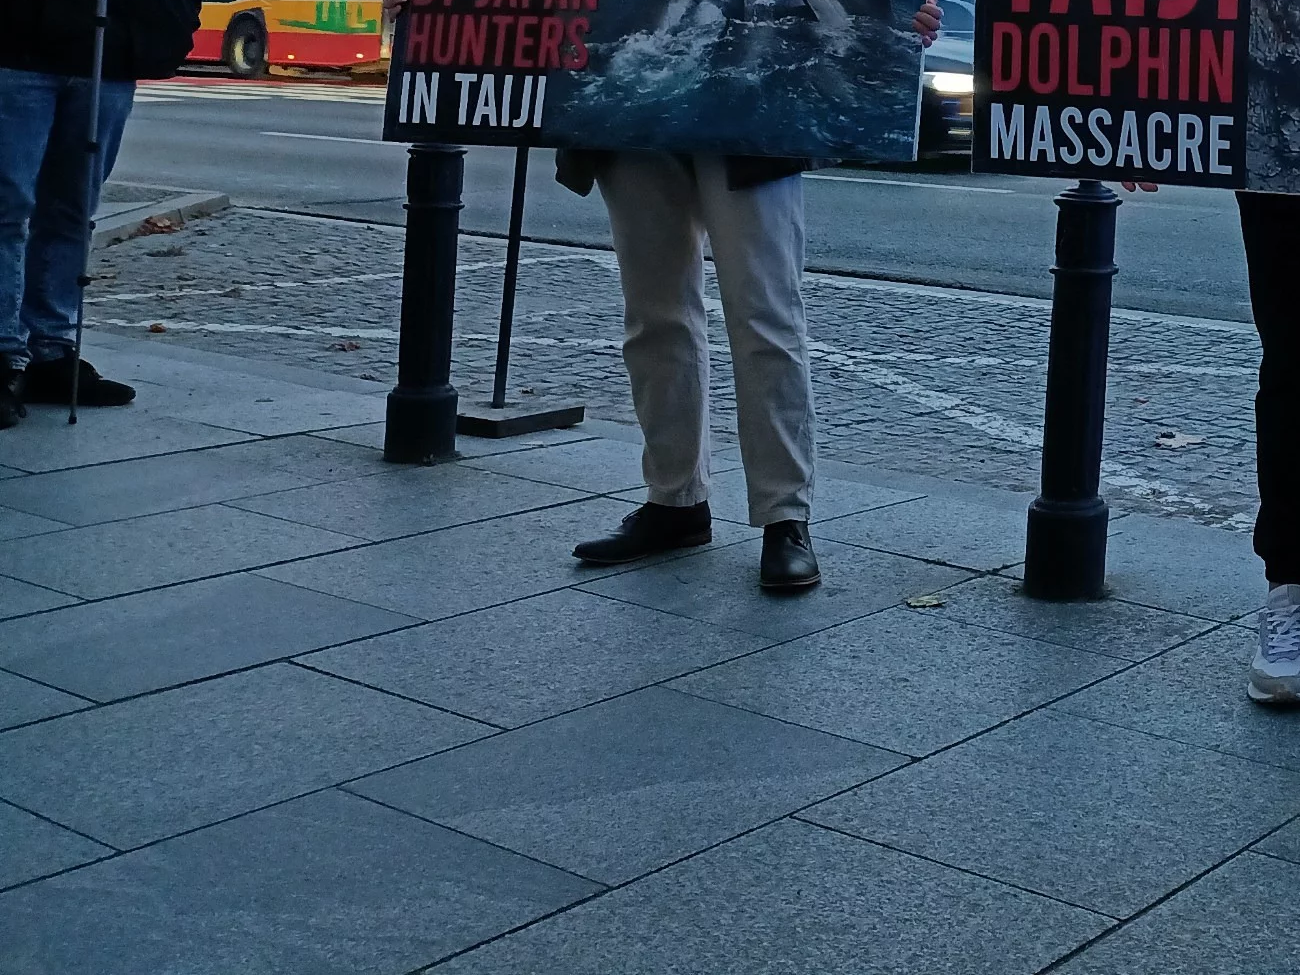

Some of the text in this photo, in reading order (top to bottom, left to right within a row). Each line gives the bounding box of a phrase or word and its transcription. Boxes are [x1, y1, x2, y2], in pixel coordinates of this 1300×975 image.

[406, 13, 590, 70] HUNTERS
[992, 21, 1235, 103] DOLPHIN
[399, 72, 547, 128] IN TAIJI
[990, 103, 1235, 175] MASSACRE
